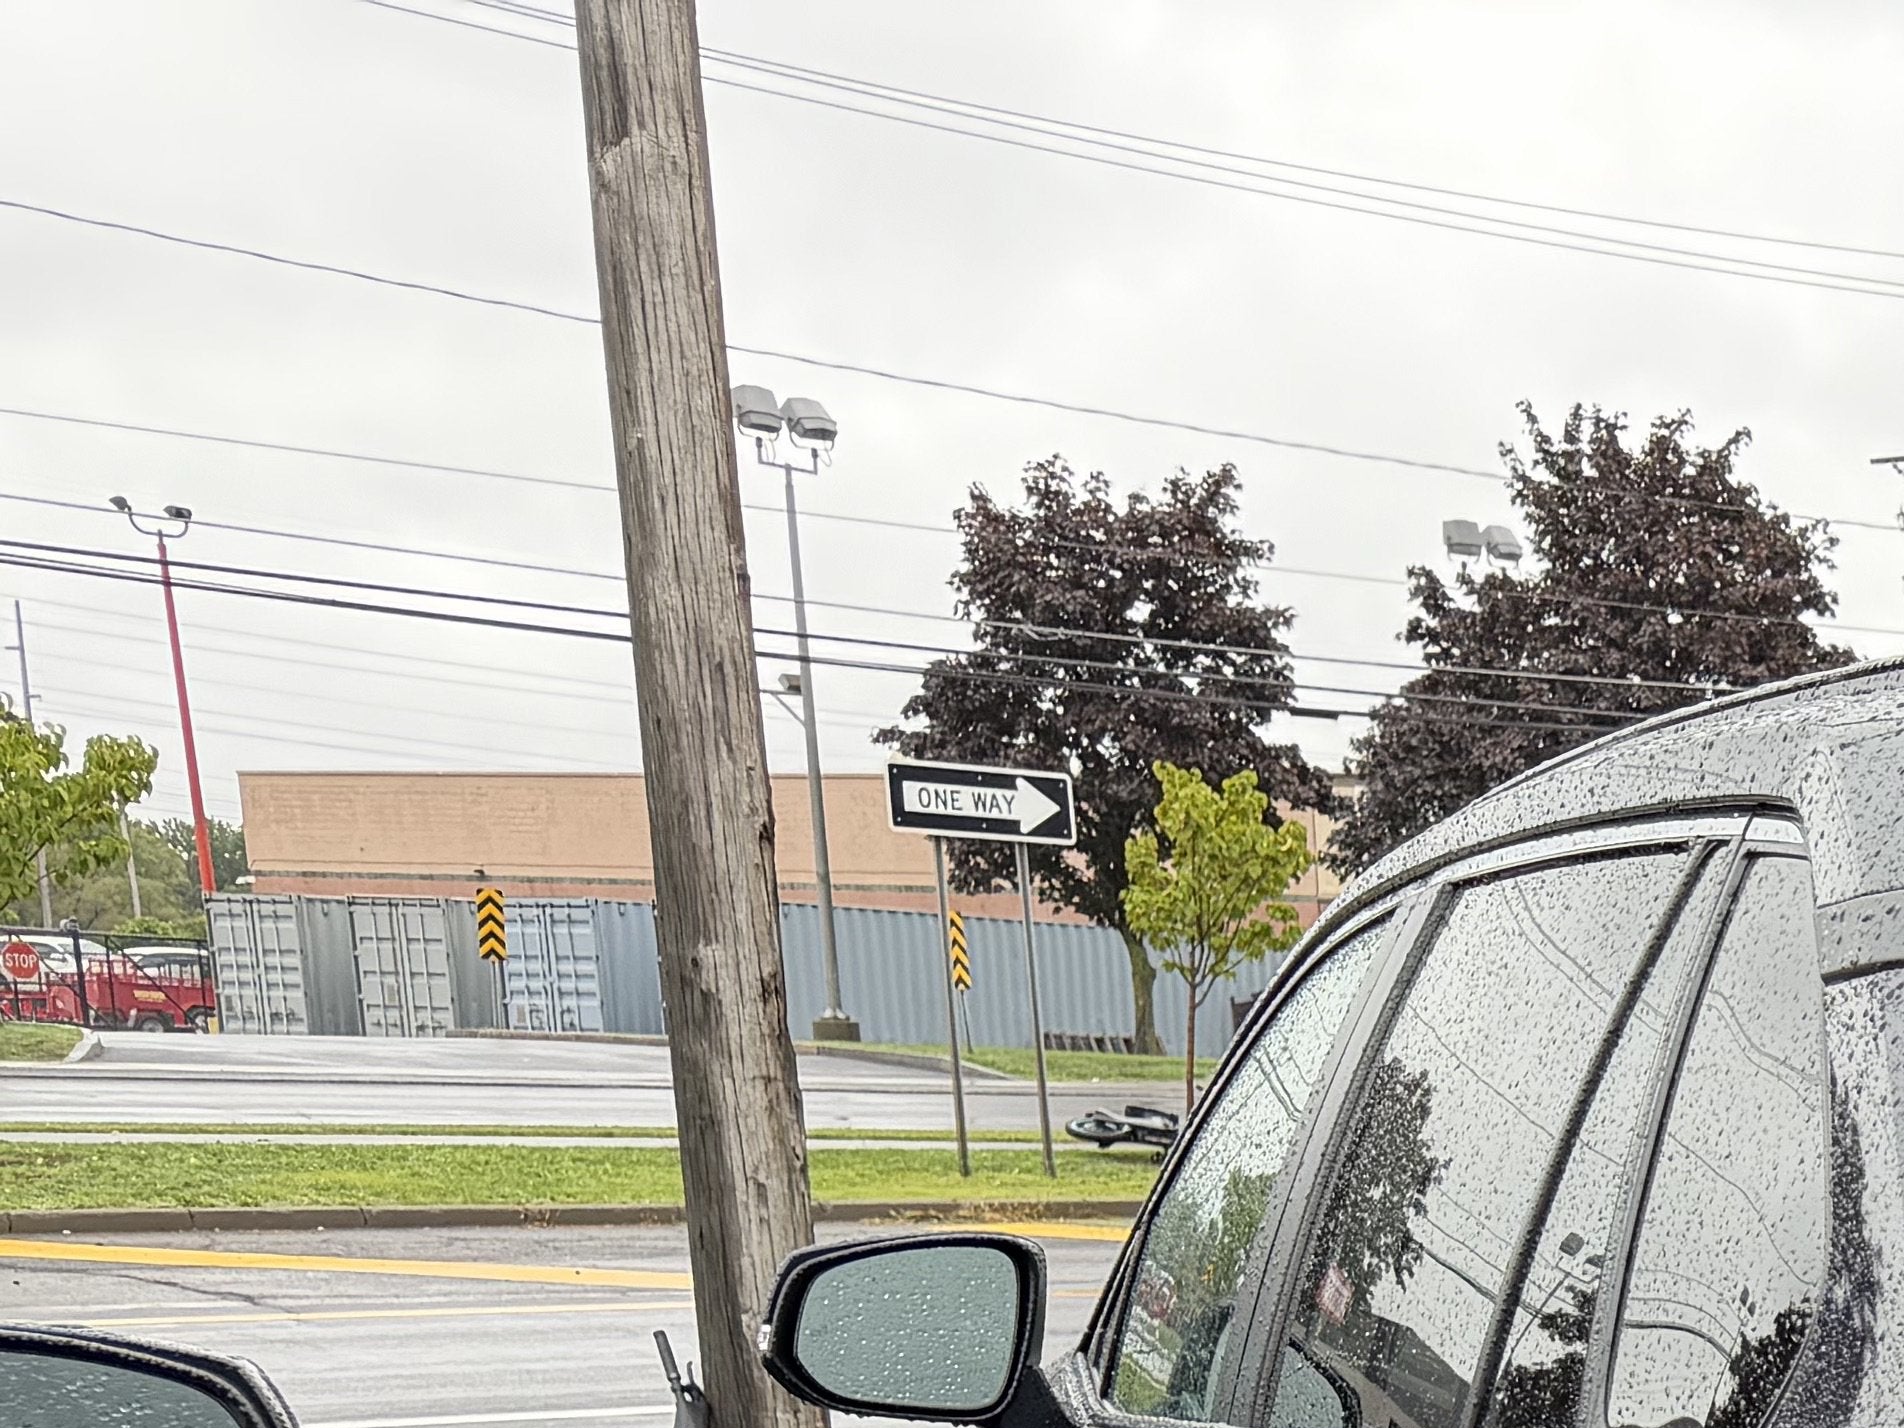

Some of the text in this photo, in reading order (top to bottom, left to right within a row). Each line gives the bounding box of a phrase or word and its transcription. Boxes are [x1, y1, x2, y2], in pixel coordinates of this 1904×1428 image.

[918, 786, 1015, 815] ONE WAY
[5, 953, 37, 969] STOP
